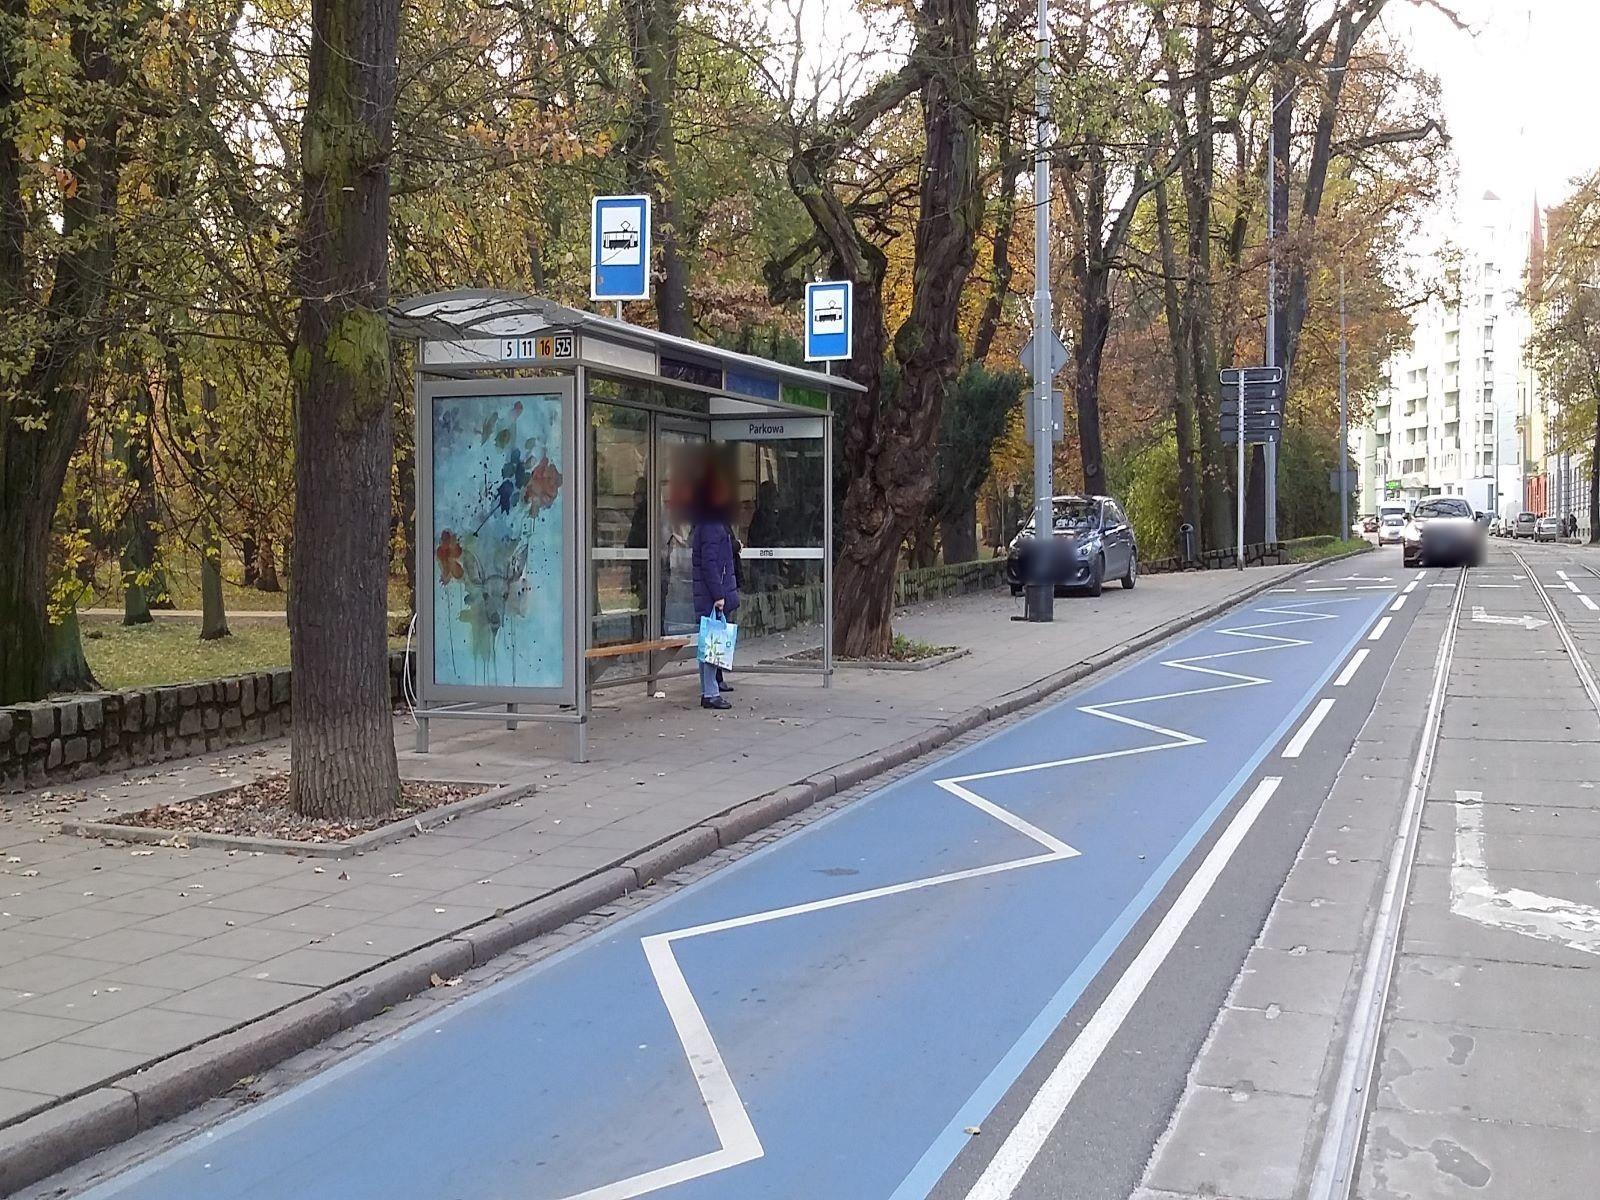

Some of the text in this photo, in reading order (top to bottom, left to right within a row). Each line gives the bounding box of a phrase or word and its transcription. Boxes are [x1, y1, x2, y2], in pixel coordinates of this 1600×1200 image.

[506, 339, 571, 357] 5 11 16 525
[749, 423, 784, 434] Parkowa
